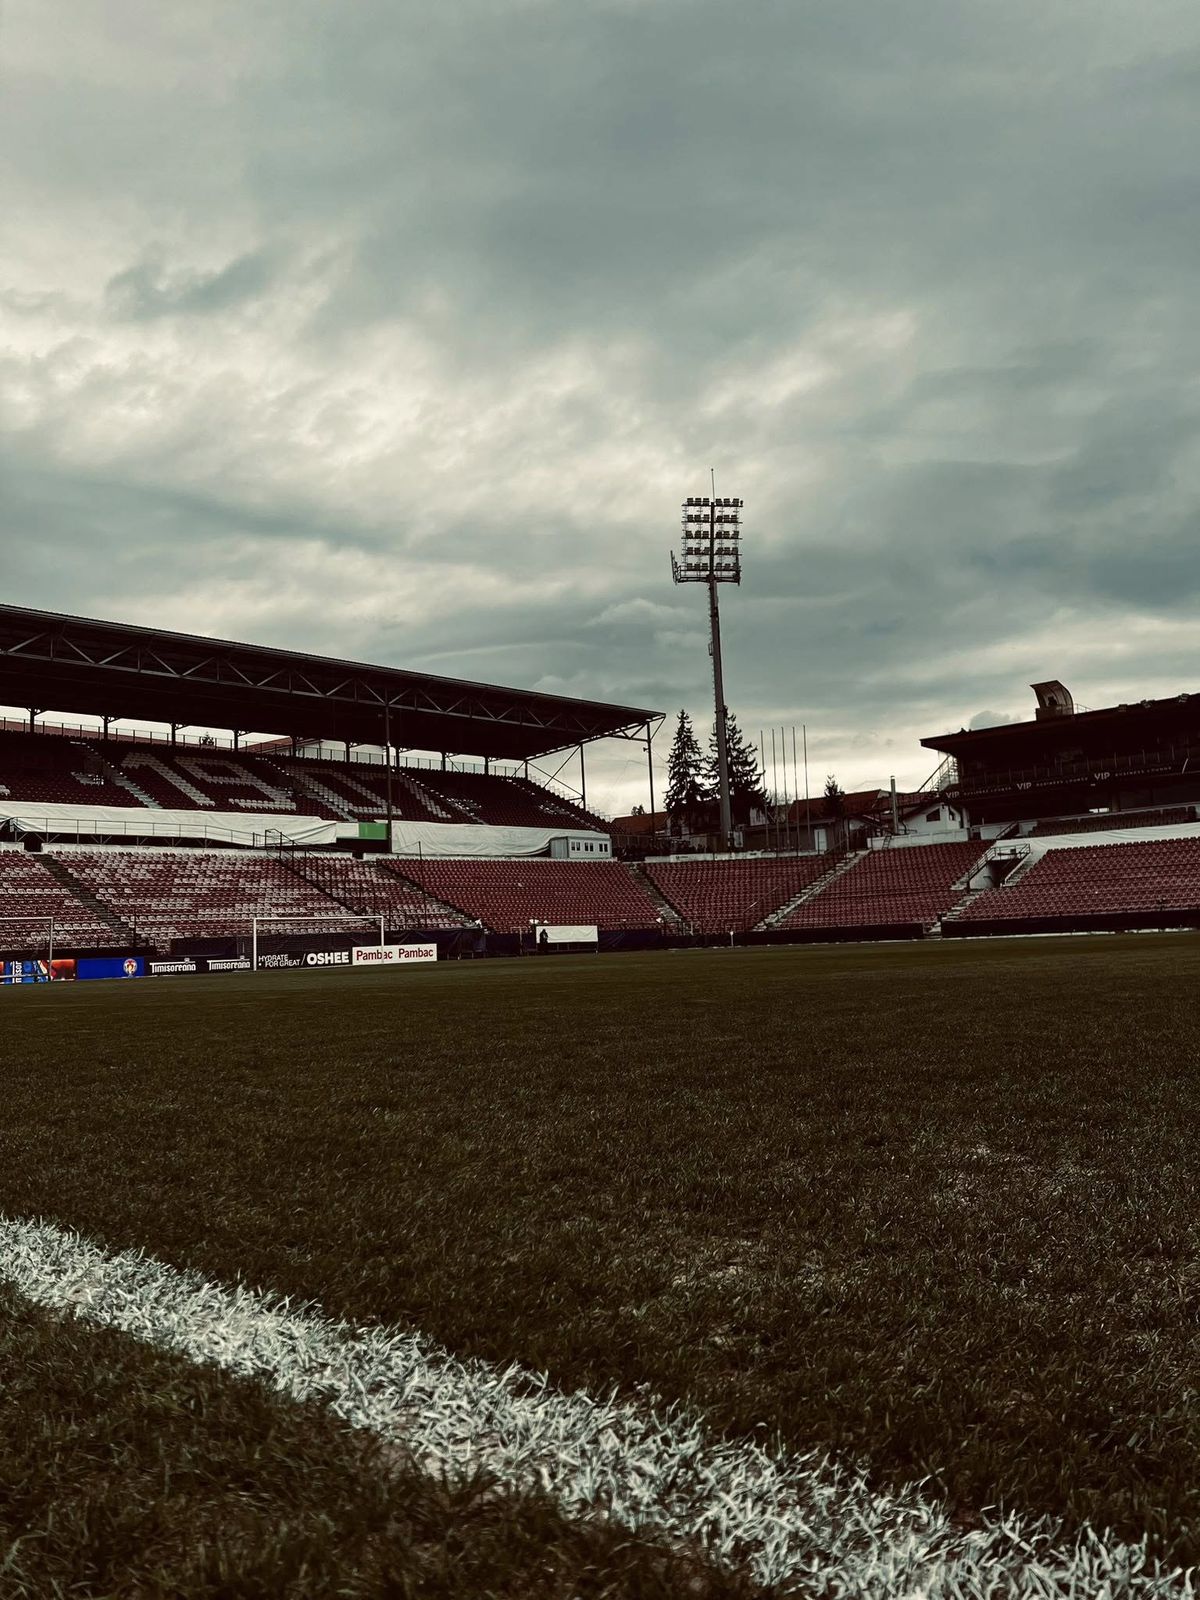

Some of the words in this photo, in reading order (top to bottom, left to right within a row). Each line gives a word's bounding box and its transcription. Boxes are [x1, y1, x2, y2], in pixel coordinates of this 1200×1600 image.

[1094, 772, 1110, 782] VIP
[1016, 782, 1032, 791] VIP
[945, 791, 960, 799] VIP
[258, 954, 288, 962] HYDRATE
[307, 951, 350, 965] OSHEE
[356, 950, 393, 961] Pambac
[398, 948, 434, 958] Pambac
[279, 959, 300, 967] GREAT
